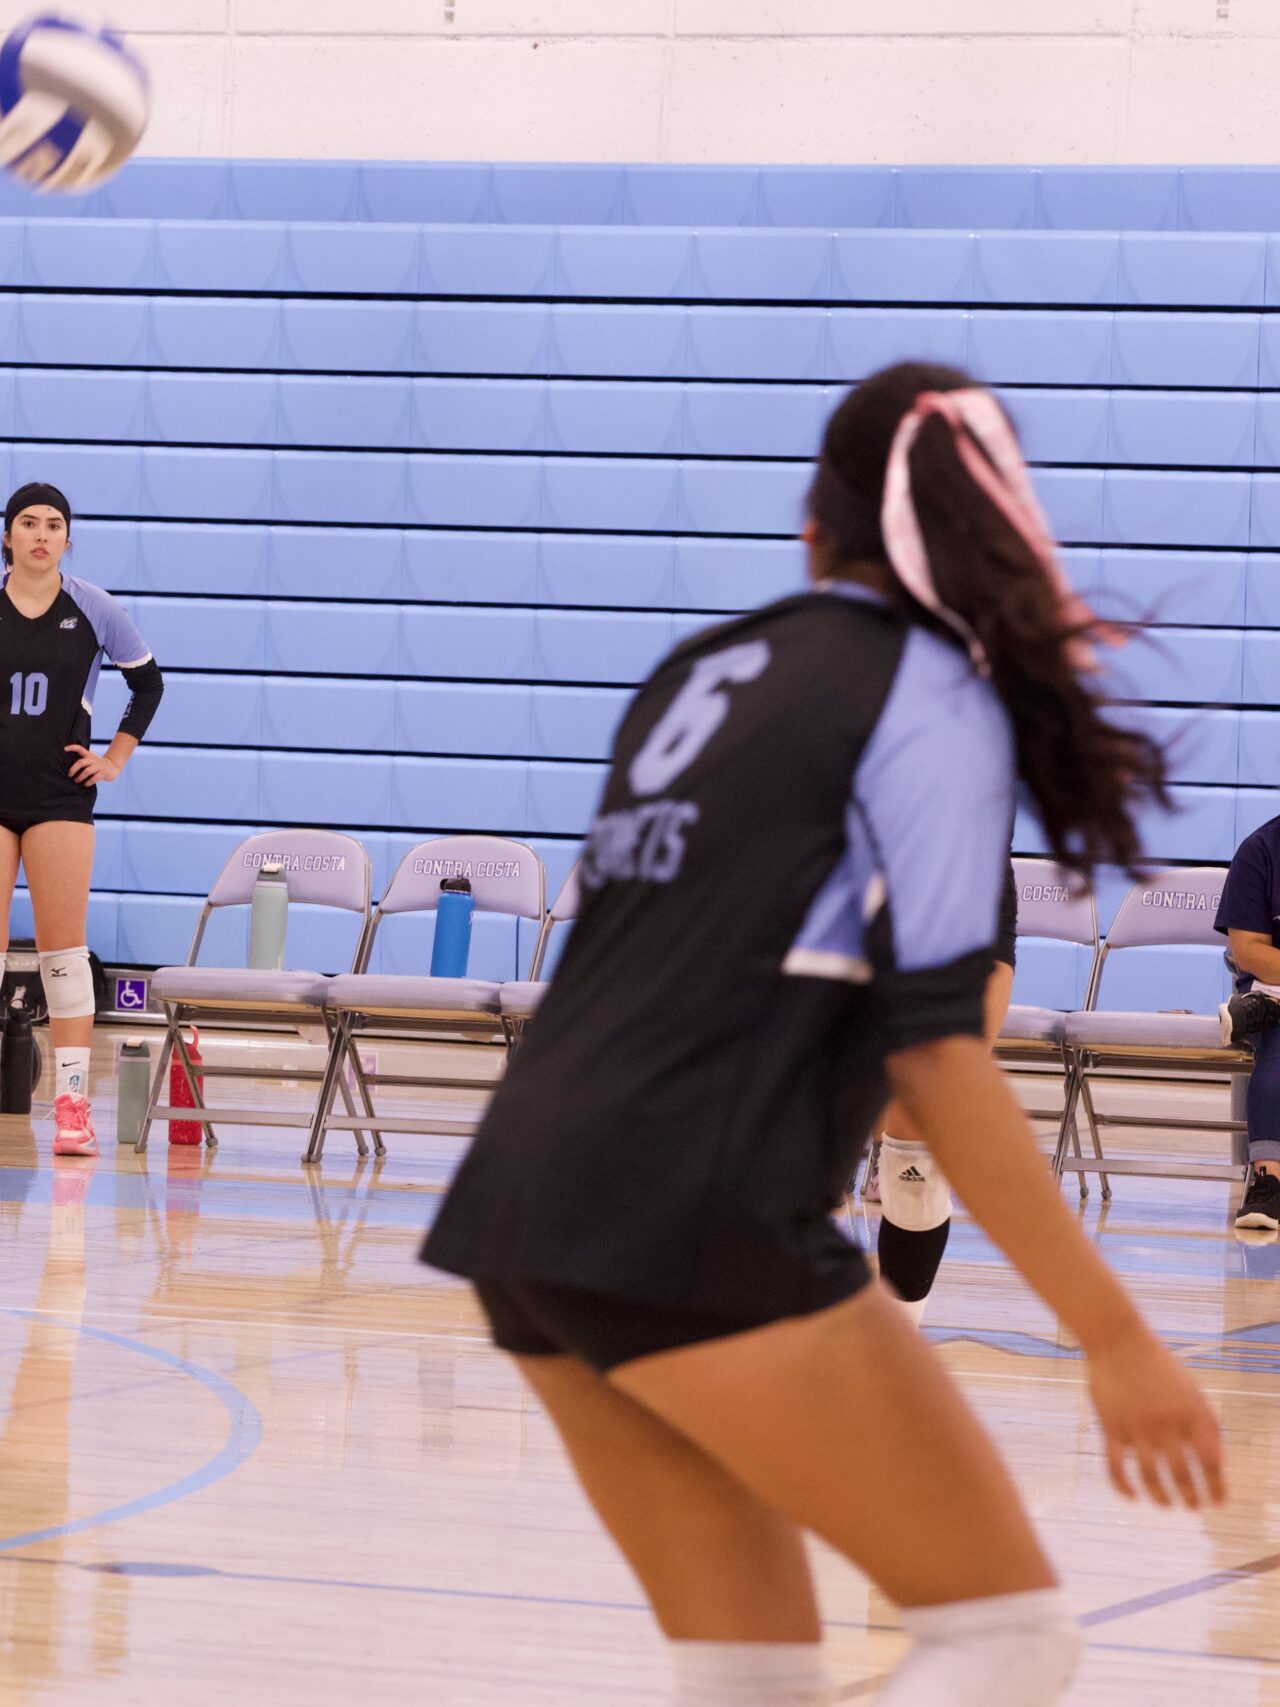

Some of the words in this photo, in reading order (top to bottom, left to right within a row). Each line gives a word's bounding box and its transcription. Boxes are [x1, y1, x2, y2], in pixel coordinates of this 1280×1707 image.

[9, 671, 49, 716] 10
[628, 638, 772, 797] 6
[242, 851, 300, 871] CONTRA
[303, 855, 346, 871] COSTA
[414, 858, 472, 877] CONTRA
[476, 861, 520, 878] COSTA
[1022, 884, 1069, 901] COSTA
[1142, 890, 1207, 910] CONTRA
